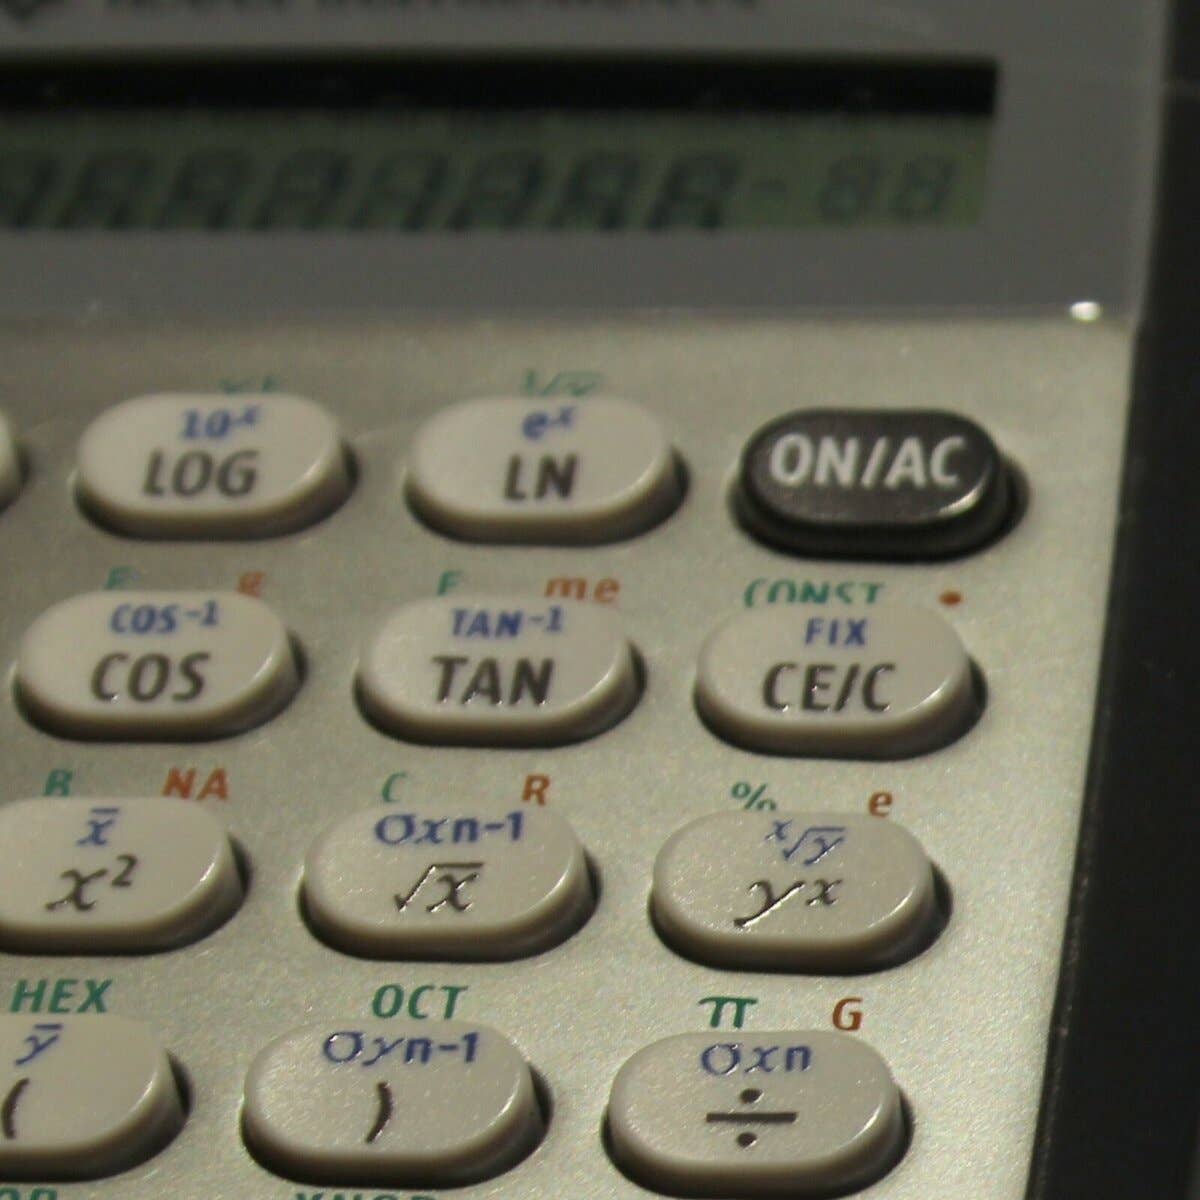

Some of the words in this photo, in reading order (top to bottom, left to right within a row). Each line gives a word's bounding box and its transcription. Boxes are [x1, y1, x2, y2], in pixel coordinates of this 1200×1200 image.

[142, 450, 258, 498] LOG
[503, 453, 579, 500] LN
[769, 432, 965, 489] ON/AC
[805, 616, 868, 647] FIX
[91, 652, 211, 702] COS
[431, 656, 555, 706] TAN
[761, 662, 897, 714] CE/C
[162, 767, 229, 800] NA
[522, 774, 550, 806] R
[868, 791, 893, 818] e
[9, 979, 114, 1015] HEX
[371, 983, 469, 1021] OCT
[831, 997, 864, 1032] G
